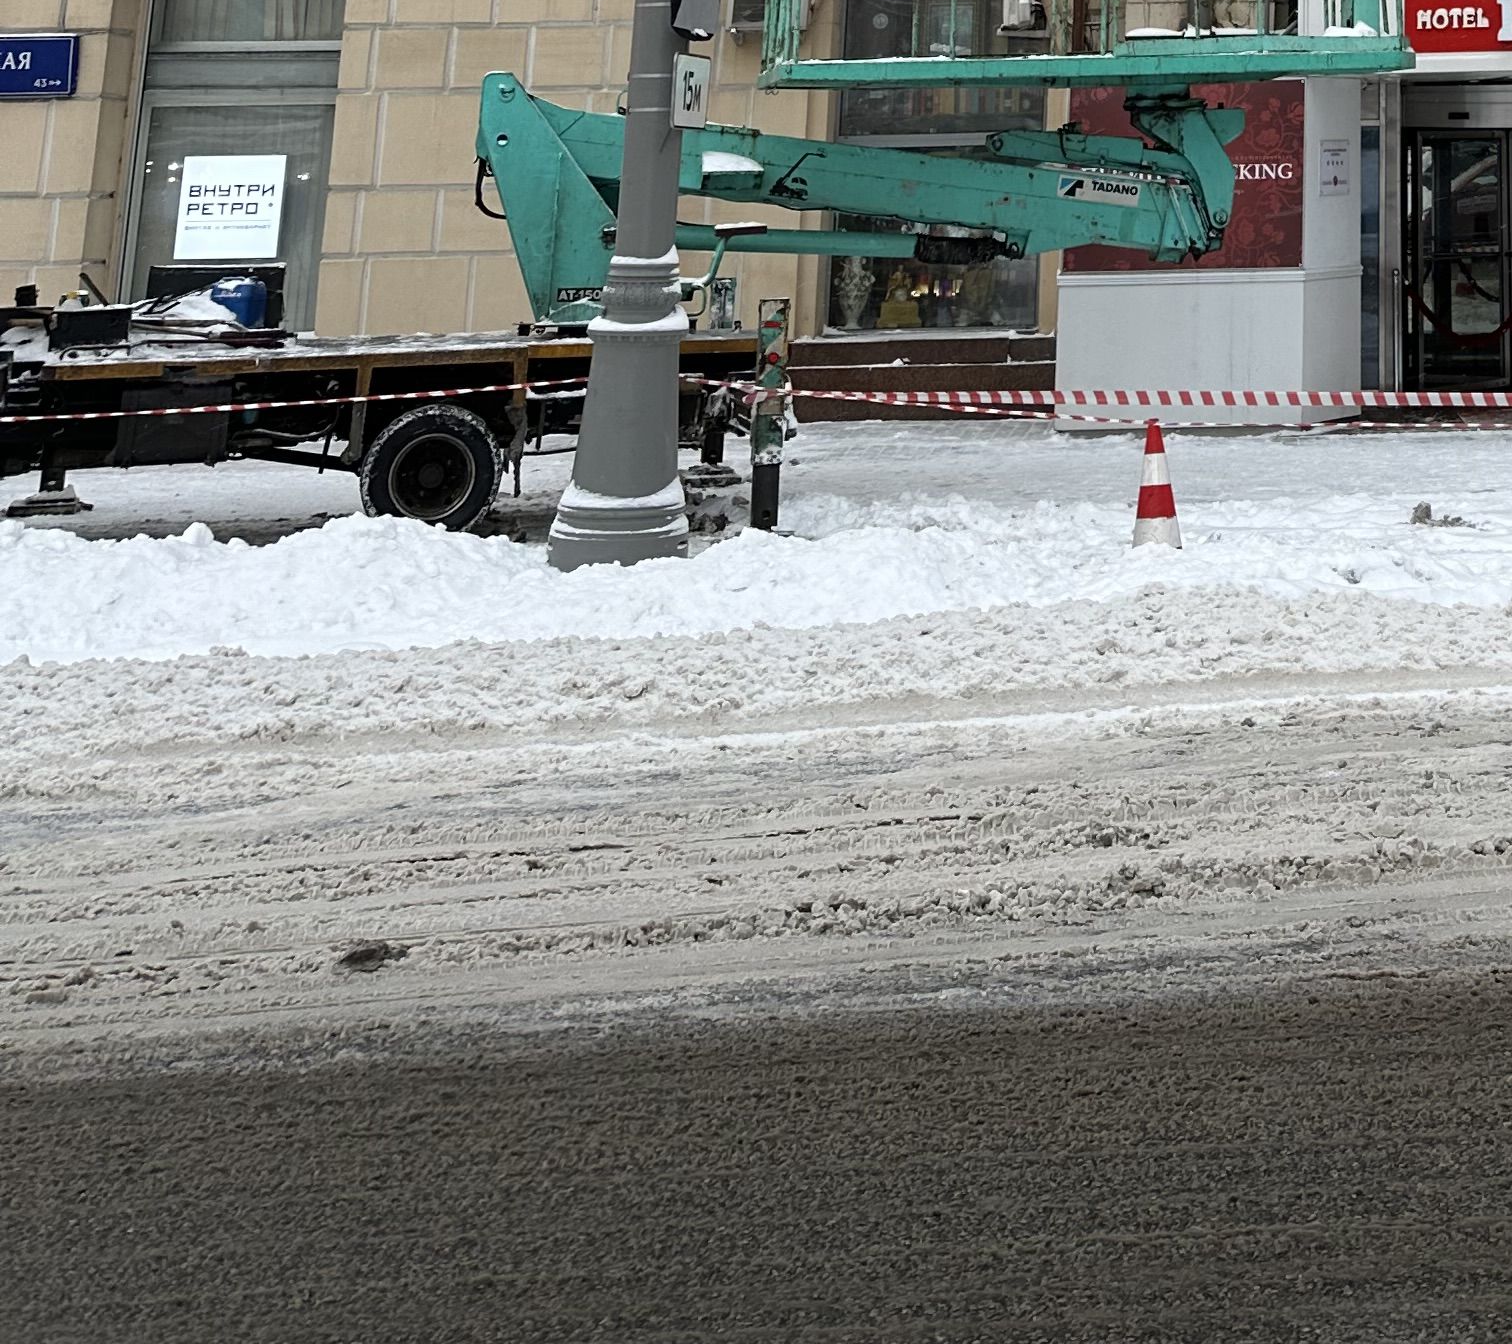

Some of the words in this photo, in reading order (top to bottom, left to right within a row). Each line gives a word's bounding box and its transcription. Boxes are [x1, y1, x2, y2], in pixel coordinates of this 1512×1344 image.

[1416, 6, 1489, 30] HOTEL
[0, 51, 32, 70] АЯ
[33, 78, 48, 88] 43
[188, 184, 275, 198] ВНУТРИ
[1091, 180, 1138, 196] TADANO
[186, 202, 259, 216] РЕТРО
